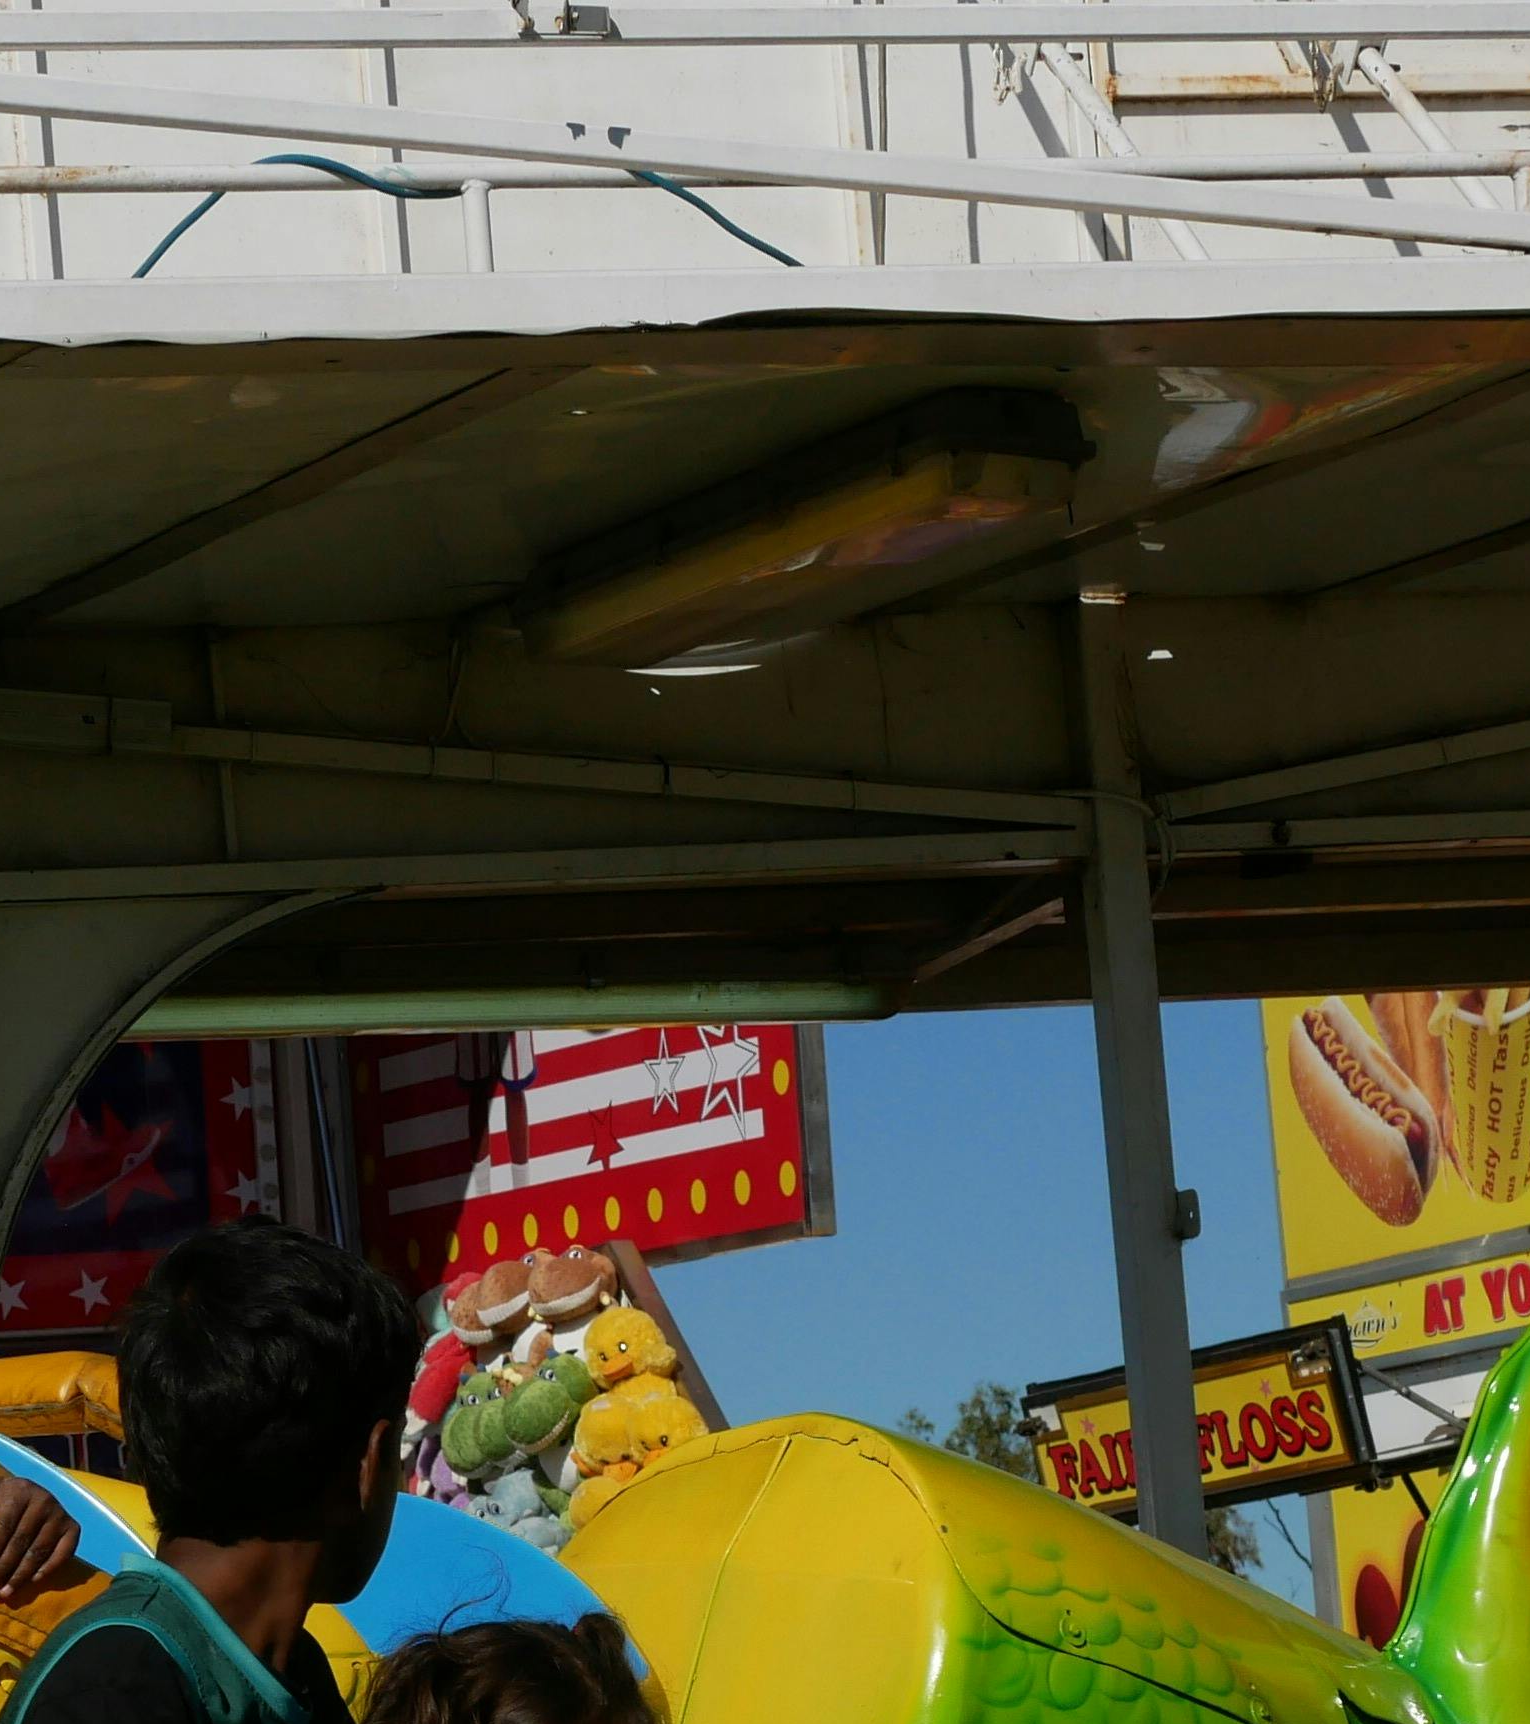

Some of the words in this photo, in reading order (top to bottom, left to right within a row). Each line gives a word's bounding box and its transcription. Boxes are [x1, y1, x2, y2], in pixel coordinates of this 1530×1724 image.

[1487, 1081, 1504, 1133] HOT
[1510, 1077, 1528, 1160] Delicious
[1481, 1146, 1501, 1200] Tasty
[1423, 1275, 1465, 1337] AT
[1194, 1390, 1332, 1475] FLOSS
